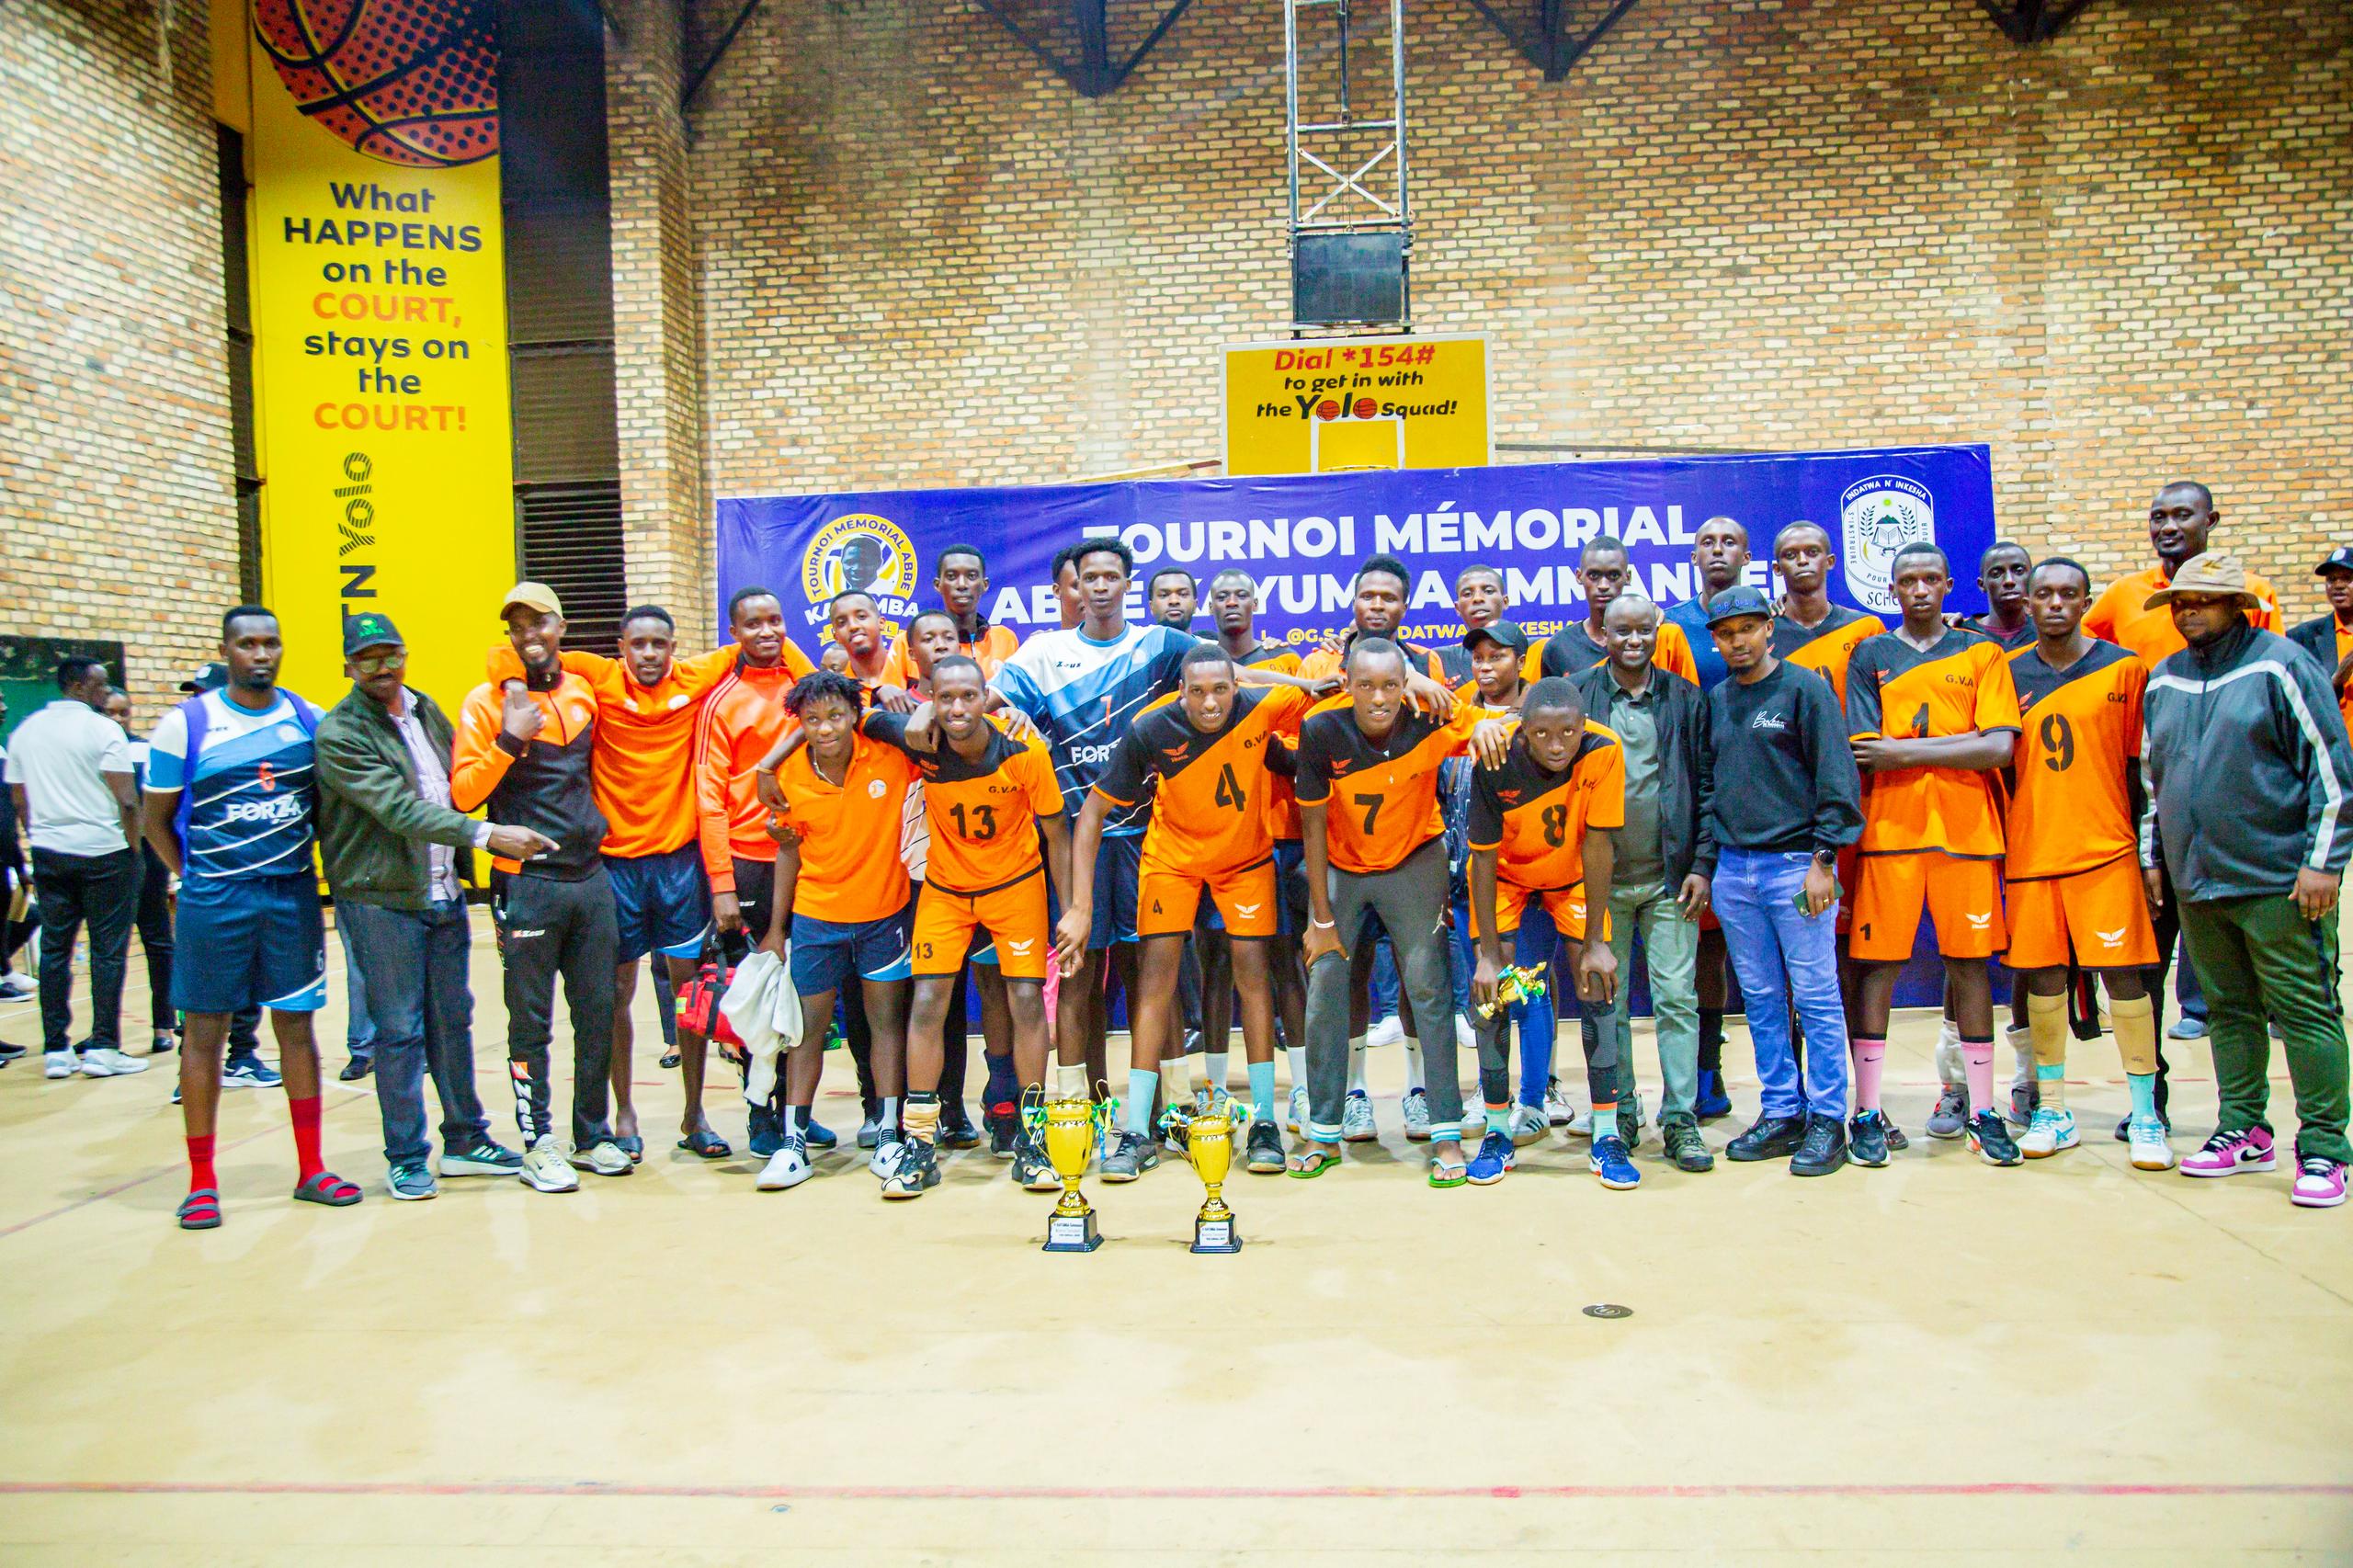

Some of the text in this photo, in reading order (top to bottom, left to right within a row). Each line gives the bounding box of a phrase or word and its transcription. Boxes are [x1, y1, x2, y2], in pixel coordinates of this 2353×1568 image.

[329, 182, 436, 212] What
[284, 217, 483, 252] HAPPENS
[323, 258, 448, 287] on the
[313, 292, 461, 328] COURT,
[304, 331, 470, 364] stays on
[1275, 347, 1333, 370] Dial
[359, 367, 421, 394] the
[1285, 370, 1424, 392] to get in with
[313, 402, 467, 432] COURT!
[1256, 403, 1292, 418] the
[1295, 392, 1378, 421] Yolo
[333, 452, 376, 557] Yolo
[1846, 480, 1881, 501] INDATWA
[1895, 480, 1927, 501] INKESHA
[1374, 501, 1698, 554] MÉMORIAL
[809, 517, 914, 597] TOURNOI MÉMORIAL ABBÉ
[988, 569, 1145, 625] ABÉ
[2040, 713, 2075, 772] 9
[258, 761, 276, 791] 6
[1214, 762, 1246, 812] 4
[949, 801, 996, 840] 13
[1354, 793, 1385, 835] 7
[1541, 803, 1567, 848] 8
[1153, 898, 1163, 915] 4
[895, 926, 904, 948] 1
[1859, 922, 1871, 941] 1
[915, 941, 934, 960] 13
